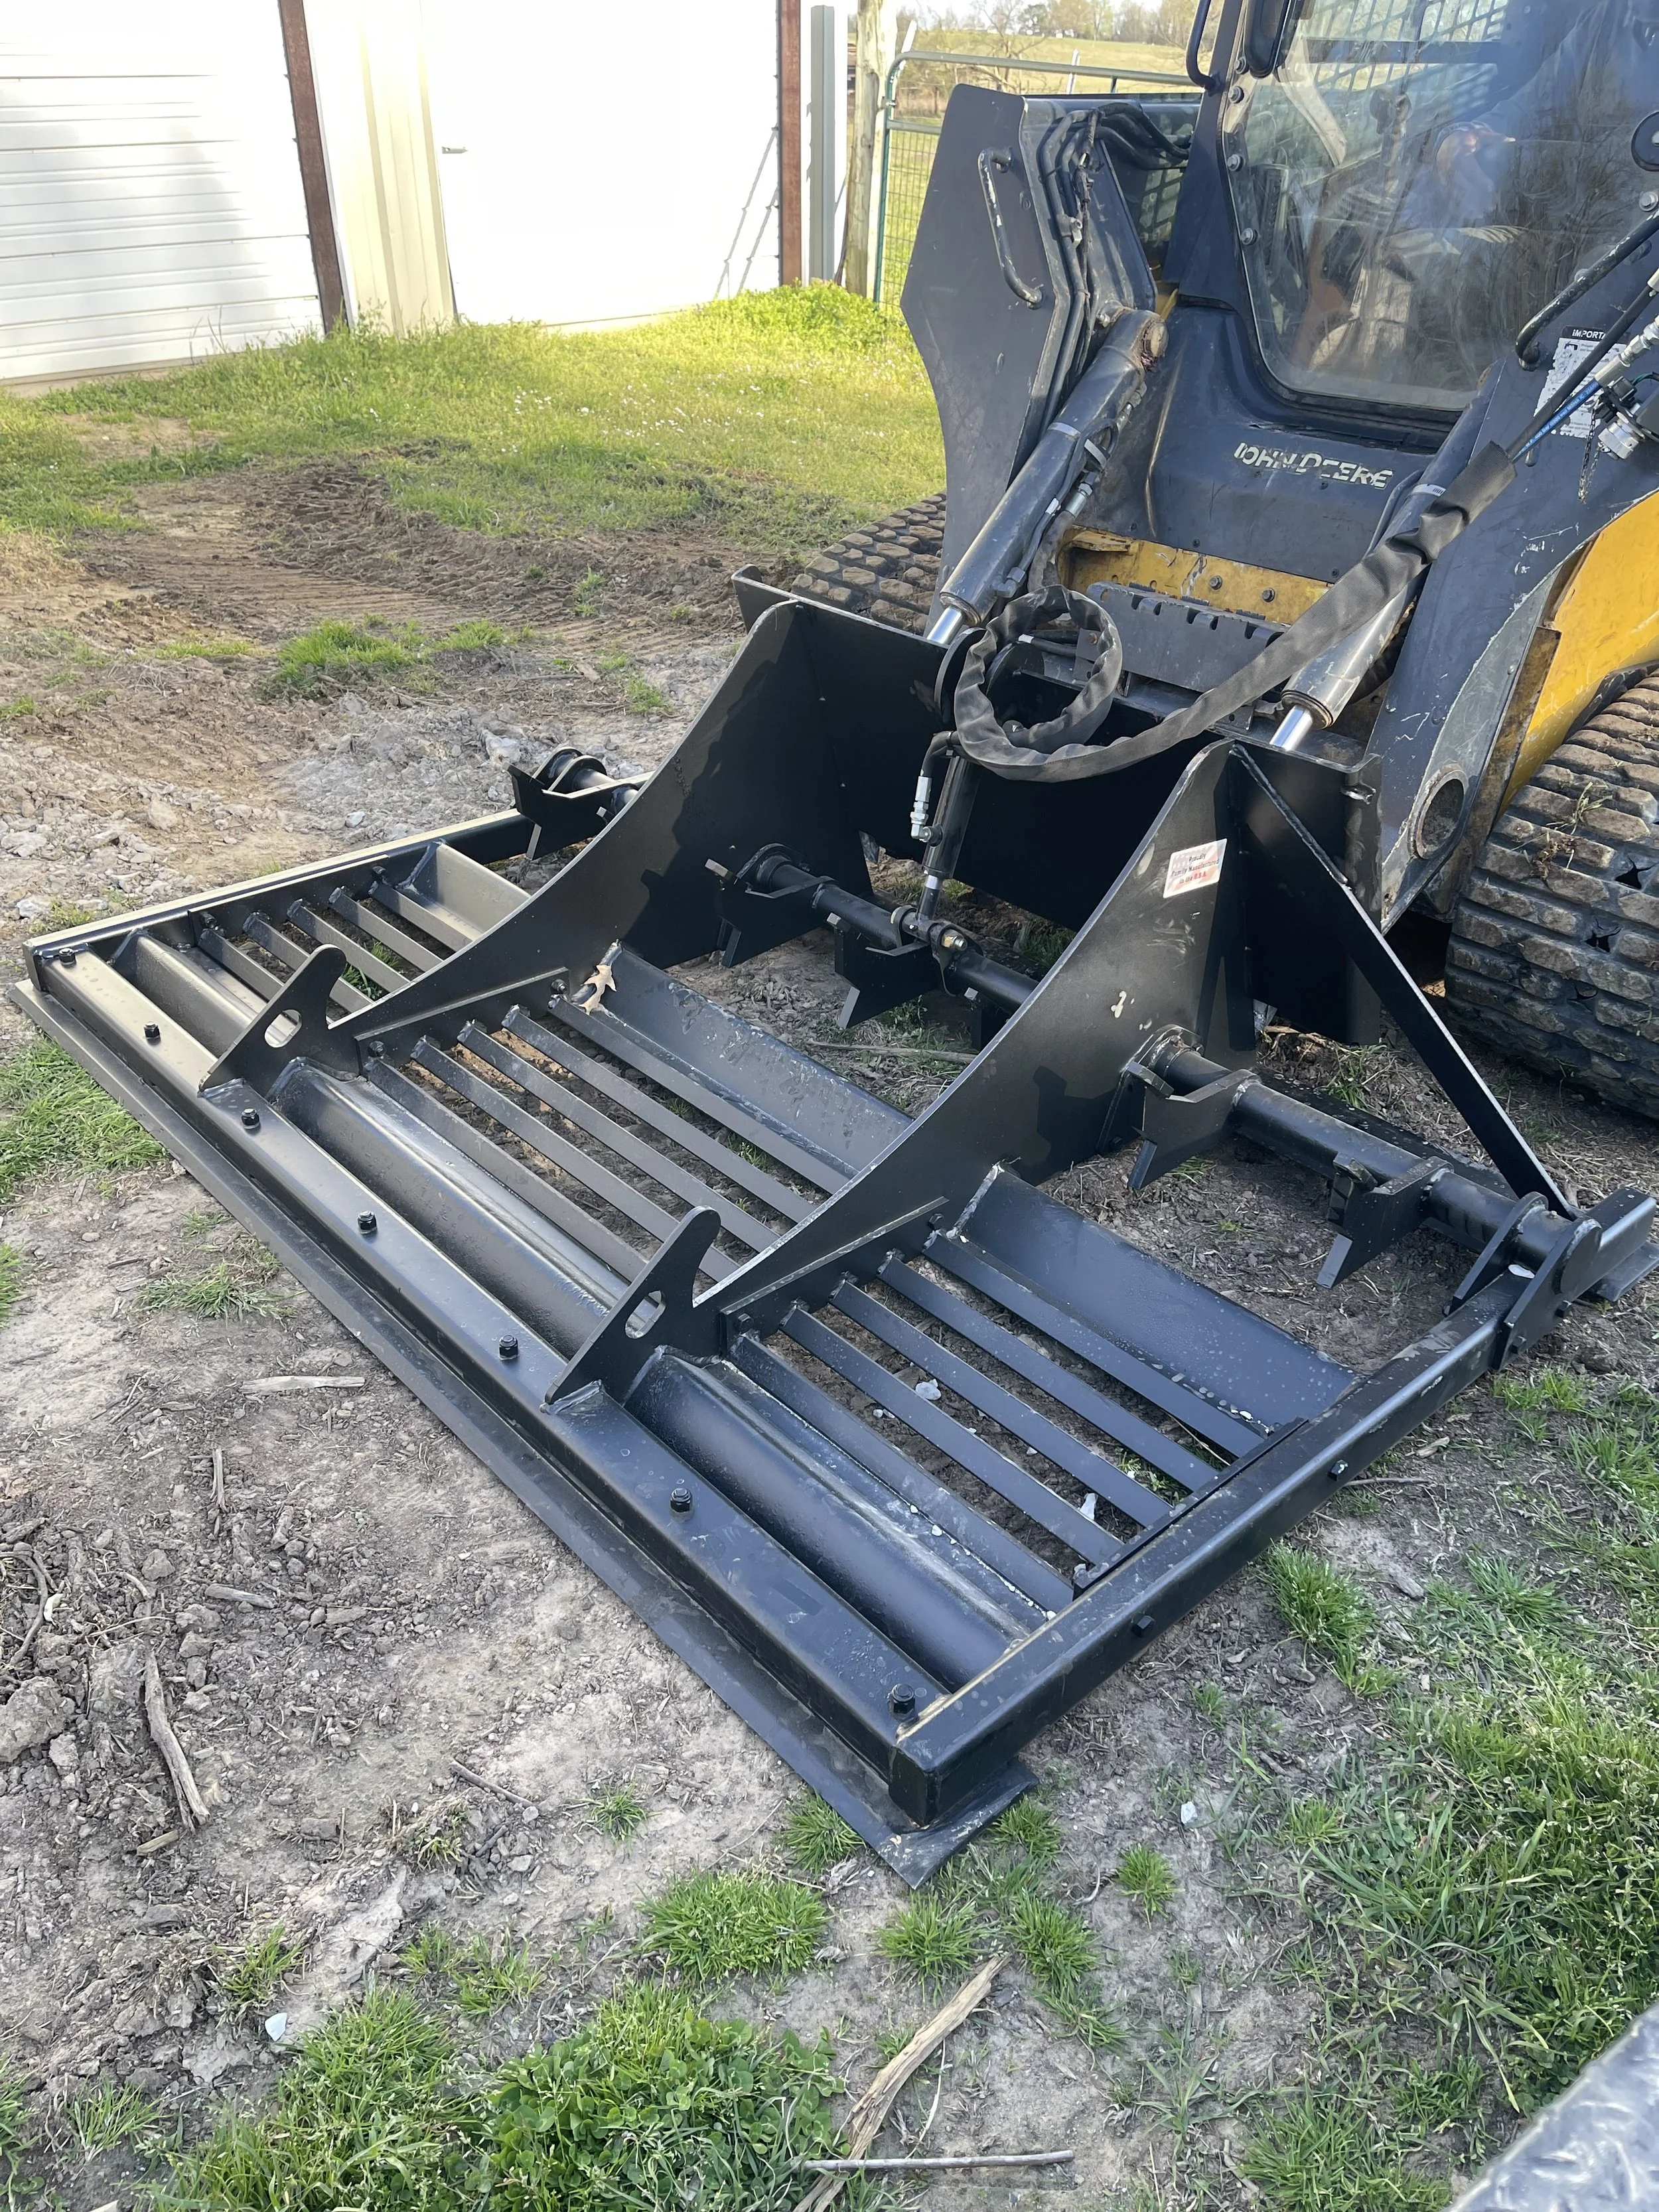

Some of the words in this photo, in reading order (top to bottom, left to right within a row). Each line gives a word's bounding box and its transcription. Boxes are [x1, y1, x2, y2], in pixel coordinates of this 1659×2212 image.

[1572, 329, 1606, 339] IMPORT
[1171, 868, 1187, 877] Family
[1189, 858, 1219, 872] Manufactured
